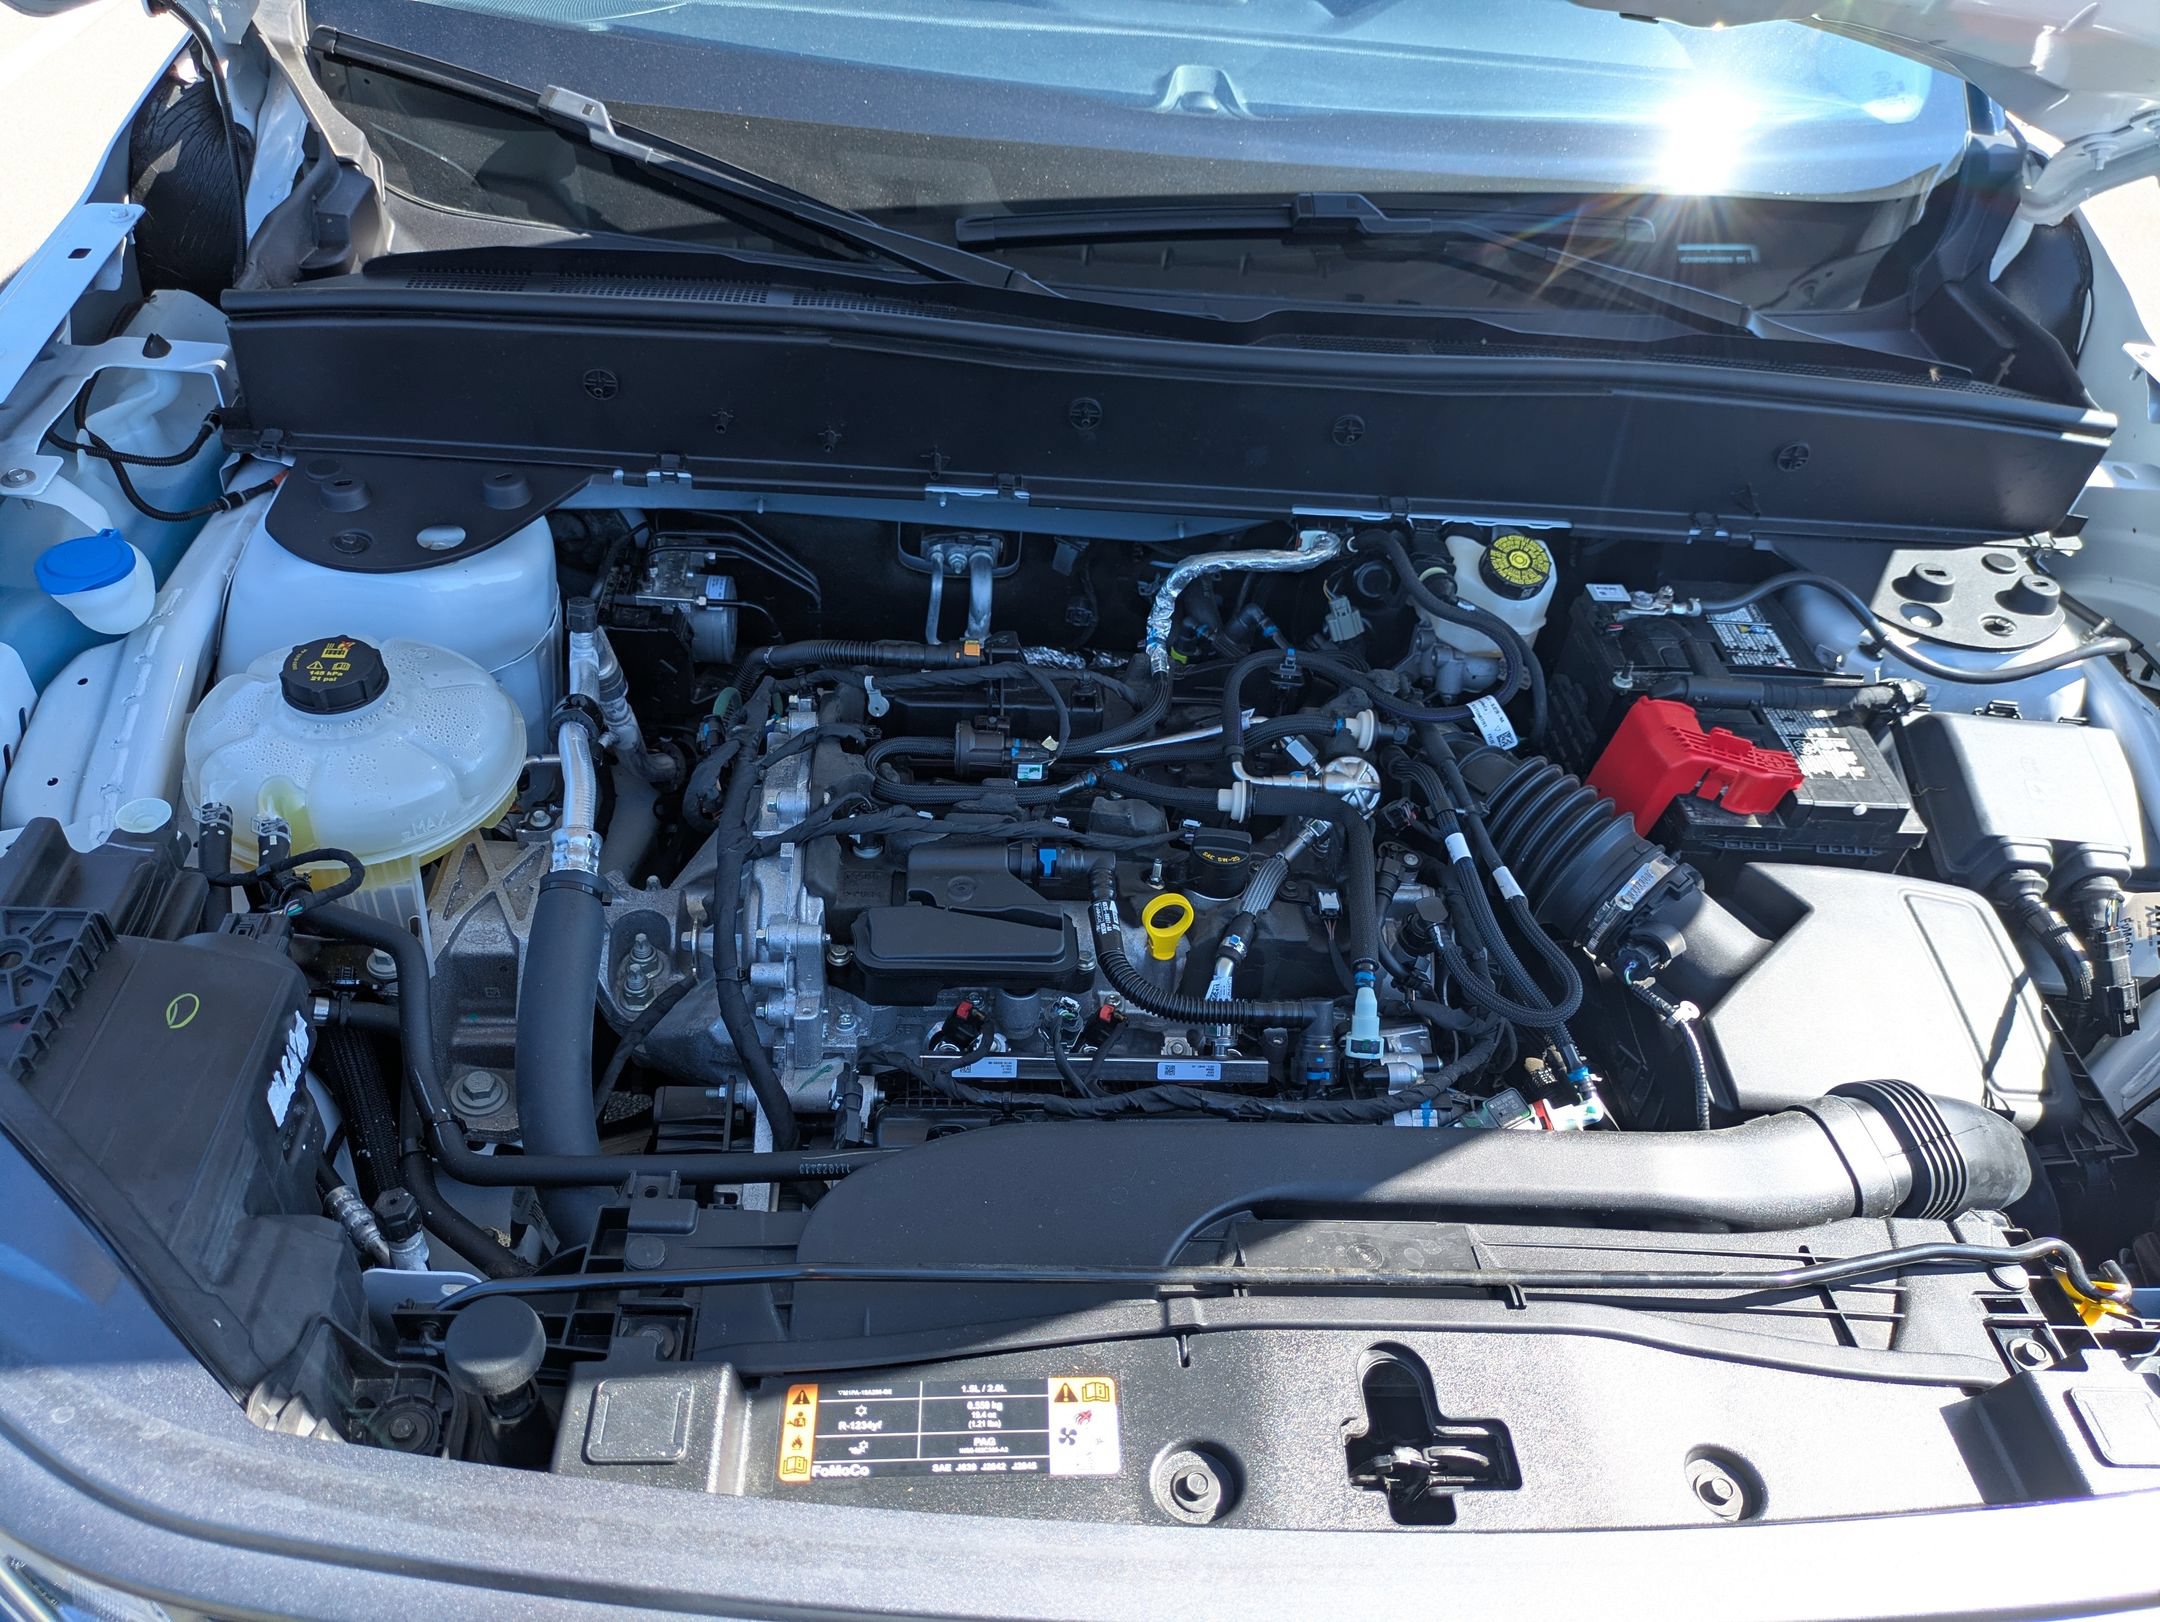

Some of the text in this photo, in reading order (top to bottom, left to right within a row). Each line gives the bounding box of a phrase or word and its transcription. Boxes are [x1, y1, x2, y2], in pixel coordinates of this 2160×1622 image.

[991, 1400, 1004, 1411] kg
[838, 1420, 883, 1432] R-1234yf
[973, 1436, 996, 1446] PAG
[811, 1463, 870, 1478] FoMoCo
[931, 1463, 952, 1472] SAE
